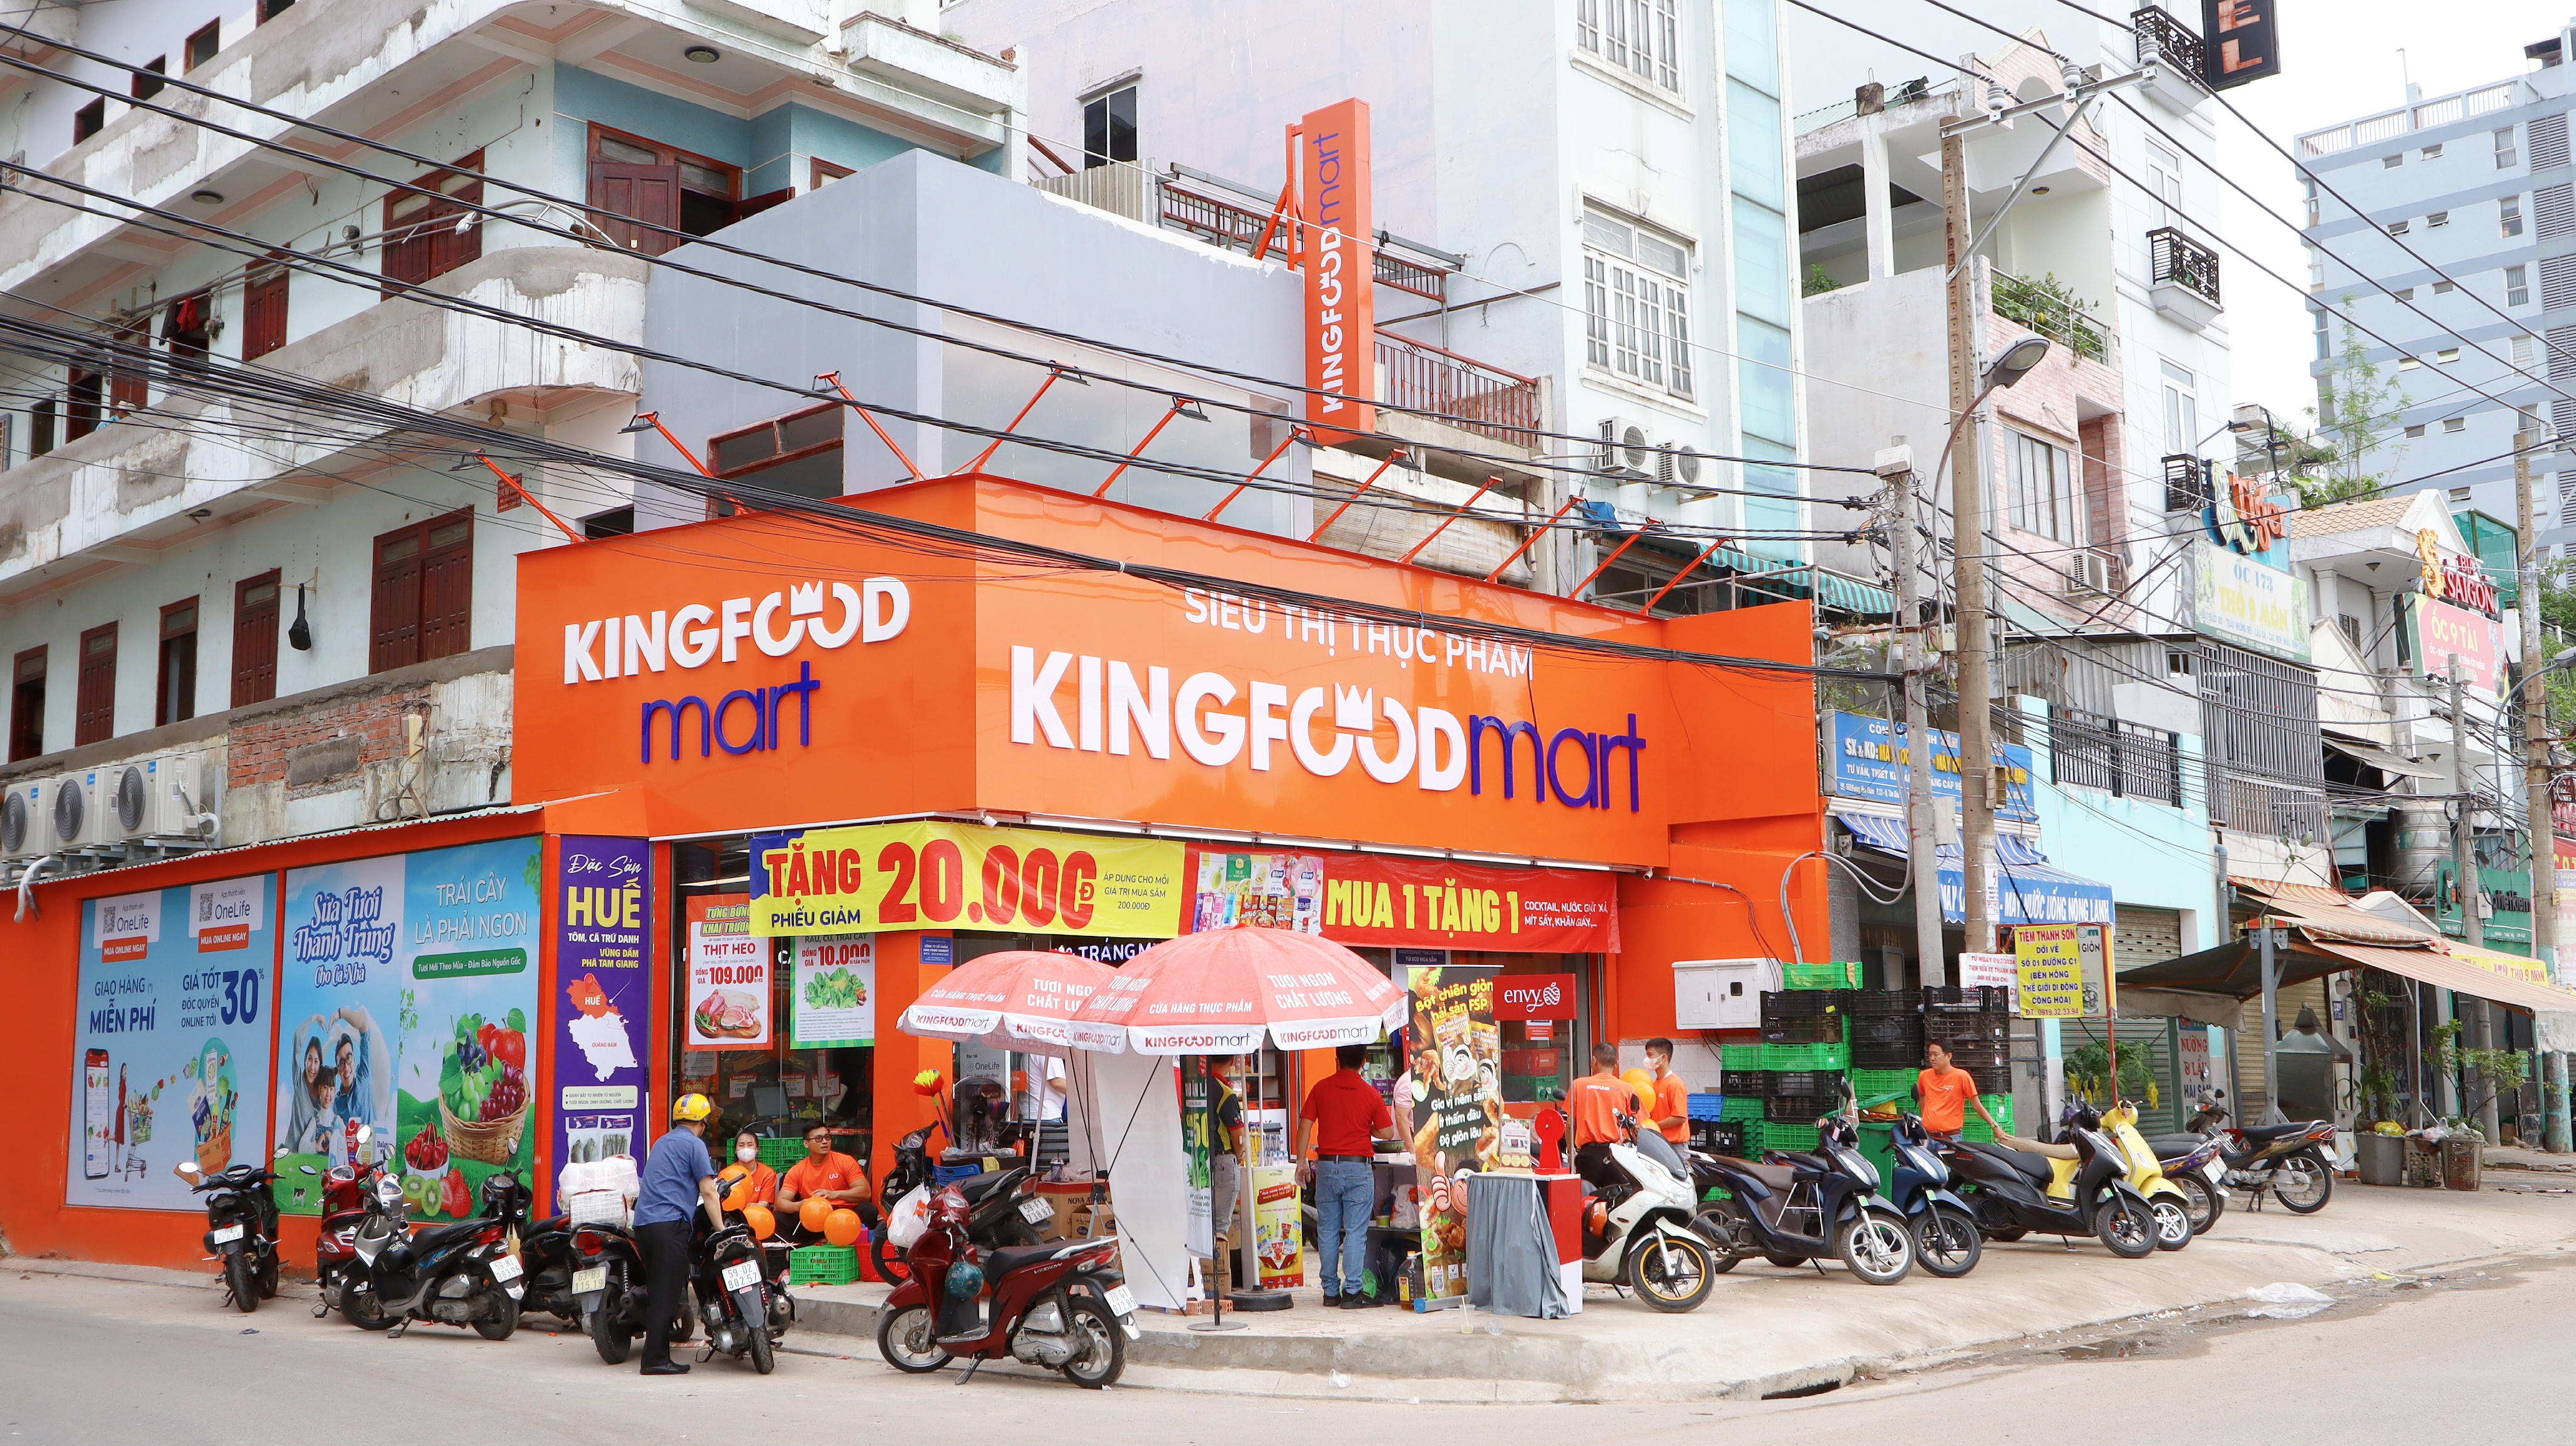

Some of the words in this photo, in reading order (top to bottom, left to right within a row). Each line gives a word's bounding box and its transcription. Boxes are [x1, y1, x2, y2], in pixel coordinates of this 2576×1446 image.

[2234, 557, 2251, 583] ỐC
[2255, 570, 2273, 592] 173
[564, 576, 911, 684] KINGFOOD
[2431, 605, 2449, 642] ỐC
[2450, 622, 2458, 645] 9
[2459, 621, 2479, 652] TÀI
[641, 660, 821, 764] mart
[1009, 644, 1646, 814] KINGFOODmart
[567, 854, 603, 874] Đặc
[608, 855, 642, 878] Sản
[766, 842, 861, 906] TẶNG
[1103, 871, 1114, 881] ÁP
[1115, 874, 1136, 884] DỤNG
[1138, 875, 1153, 884] CHO
[1155, 874, 1169, 884] MỖI
[436, 874, 472, 908] TRÁI
[475, 871, 507, 903] CÂY
[1104, 885, 1116, 895] GIÁ
[1119, 887, 1130, 898] TRỊ
[1131, 888, 1148, 896] MUA
[1150, 887, 1166, 898] SẮM
[215, 900, 250, 920] OneLife
[311, 893, 341, 928] Sữa
[344, 888, 381, 921] Tươi
[567, 877, 641, 928] HUẾ
[1118, 901, 1150, 910] 200.000Đ
[1326, 879, 1394, 929] MUA
[1401, 884, 1415, 930] 1
[1423, 878, 1502, 939] TẶNG
[1506, 891, 1519, 934] 1
[1524, 901, 1560, 913] COCKTAIL,
[1562, 900, 1583, 913] NƯỚC
[2068, 891, 2089, 923] NÓNG
[117, 914, 149, 933] OneLife
[771, 904, 815, 928] PHIẾU
[819, 905, 861, 927] GIẢM
[1524, 913, 1537, 926] MÍT
[1538, 913, 1554, 927] SẤY,
[1555, 915, 1576, 926] KHĂN
[415, 913, 435, 945] LÀ
[438, 909, 475, 943] PHẢI
[479, 911, 528, 939] NGON
[201, 935, 213, 945] MUA
[213, 933, 231, 944] ONLINE
[232, 932, 247, 942] NGAY
[293, 925, 340, 961] Thanh
[343, 923, 393, 961] Trùng
[568, 931, 587, 943] TÔM,
[589, 931, 599, 943] CÁ
[618, 935, 640, 944] DANH
[2019, 931, 2035, 946] TIỆM
[2038, 929, 2060, 942] THANH
[2062, 926, 2075, 940] SƠN
[104, 947, 114, 956] MUA
[115, 945, 132, 954] ONLINE
[132, 943, 145, 953] NGAY
[599, 947, 621, 957] VÙNG
[703, 944, 729, 959] THỊT
[732, 943, 755, 955] HEO
[1078, 938, 1135, 962] TRÁNG
[2036, 945, 2048, 954] DỜI
[2050, 943, 2060, 953] VỀ
[2082, 942, 2100, 952] GIÒN
[581, 957, 597, 967] PHÁ
[599, 959, 614, 968] TAM
[616, 959, 639, 969] GIANG
[804, 957, 814, 967] GIÁ
[2021, 956, 2031, 967] SỐ
[2032, 959, 2040, 967] 01
[2042, 955, 2067, 966] ĐƯỜNG
[182, 969, 199, 991] GIÁ
[202, 965, 221, 989] TỐT
[315, 965, 331, 987] Cho
[343, 963, 365, 985] Nhà
[1267, 974, 1296, 989] TƯƠI
[1298, 972, 1338, 987] NGON
[2030, 972, 2046, 981] (BÊN
[2048, 970, 2069, 979] HÔNG
[2531, 967, 2545, 982] MÓN
[95, 980, 116, 996] GIAO
[119, 974, 145, 994] HÀNG
[1032, 978, 1062, 993] TƯƠI
[2023, 982, 2036, 992] THẾ
[2037, 982, 2051, 991] GIỚI
[584, 994, 602, 1006] HUẾ
[945, 991, 966, 999] HÀNG
[1027, 992, 1058, 1009] CHẤT
[1275, 991, 1309, 1009] CHẤT
[1311, 988, 1353, 1006] LƯỢNG
[1415, 994, 1436, 1013] Bột
[1438, 983, 1468, 1001] chiên
[1470, 978, 1494, 996] giòn
[1504, 988, 1544, 1013] envy
[182, 999, 196, 1013] ĐỘC
[1149, 1001, 1168, 1014] CỬA
[1170, 999, 1196, 1014] HÀNG
[1198, 1002, 1223, 1015] THỰC
[1224, 999, 1253, 1013] PHẨM
[1430, 1006, 1447, 1022] hải
[1449, 1000, 1467, 1016] sản
[1468, 998, 1488, 1011] FSP
[90, 998, 125, 1034] MIỄN
[130, 998, 157, 1032] PHÍ
[181, 1016, 204, 1028] ONLINE
[205, 1013, 216, 1027] TỚI
[1145, 1033, 1251, 1048] KINGFOODmart
[1280, 1025, 1369, 1044] KINGFOODmart
[975, 1062, 1000, 1071] OneLife
[2184, 1079, 2196, 1098] HẢI
[1431, 1098, 1445, 1111] Gia
[1446, 1096, 1453, 1109] vị
[1455, 1093, 1472, 1106] nêm
[1445, 1111, 1465, 1126] thấm
[1439, 1133, 1450, 1147] Độ
[1452, 1130, 1469, 1145] giòn
[1470, 1127, 1482, 1138] lâu
[1023, 1199, 1043, 1213] 59-F1
[1026, 1206, 1052, 1223] 738.87
[496, 1265, 521, 1281] 383.96
[1033, 1262, 1063, 1274] VISION
[575, 1279, 603, 1291] 115.19
[728, 1272, 758, 1289] 882.57
[1109, 1287, 1128, 1303] 70-G1
[1113, 1298, 1137, 1314] 872.85
